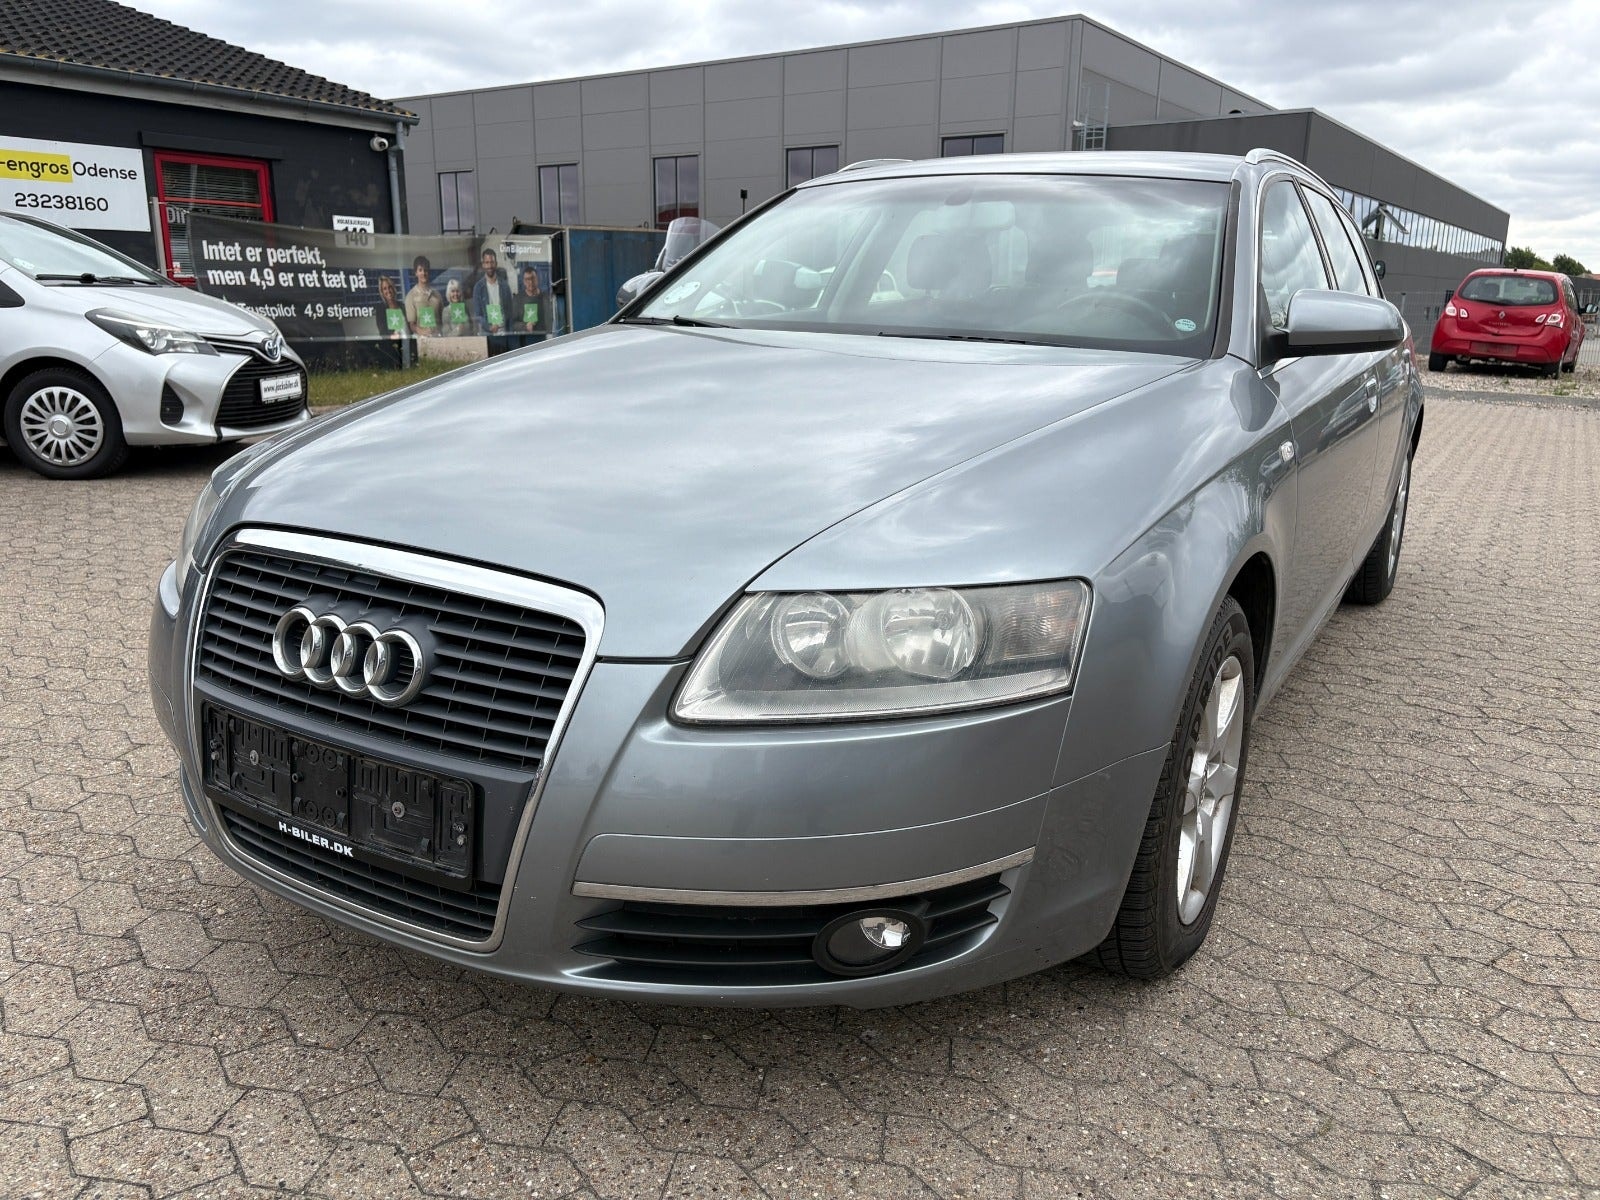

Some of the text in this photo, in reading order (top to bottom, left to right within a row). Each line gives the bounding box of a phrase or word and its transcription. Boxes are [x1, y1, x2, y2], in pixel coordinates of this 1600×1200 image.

[73, 161, 137, 180] Odense
[15, 193, 108, 211] 23238160
[342, 227, 368, 247] 140
[202, 240, 326, 268] Intet er perfekt,
[207, 268, 367, 292] men 4,9 er ret tæt på
[304, 303, 324, 320] 4,9
[327, 304, 375, 320] stjerner
[278, 821, 354, 858] H-BILER.DK
